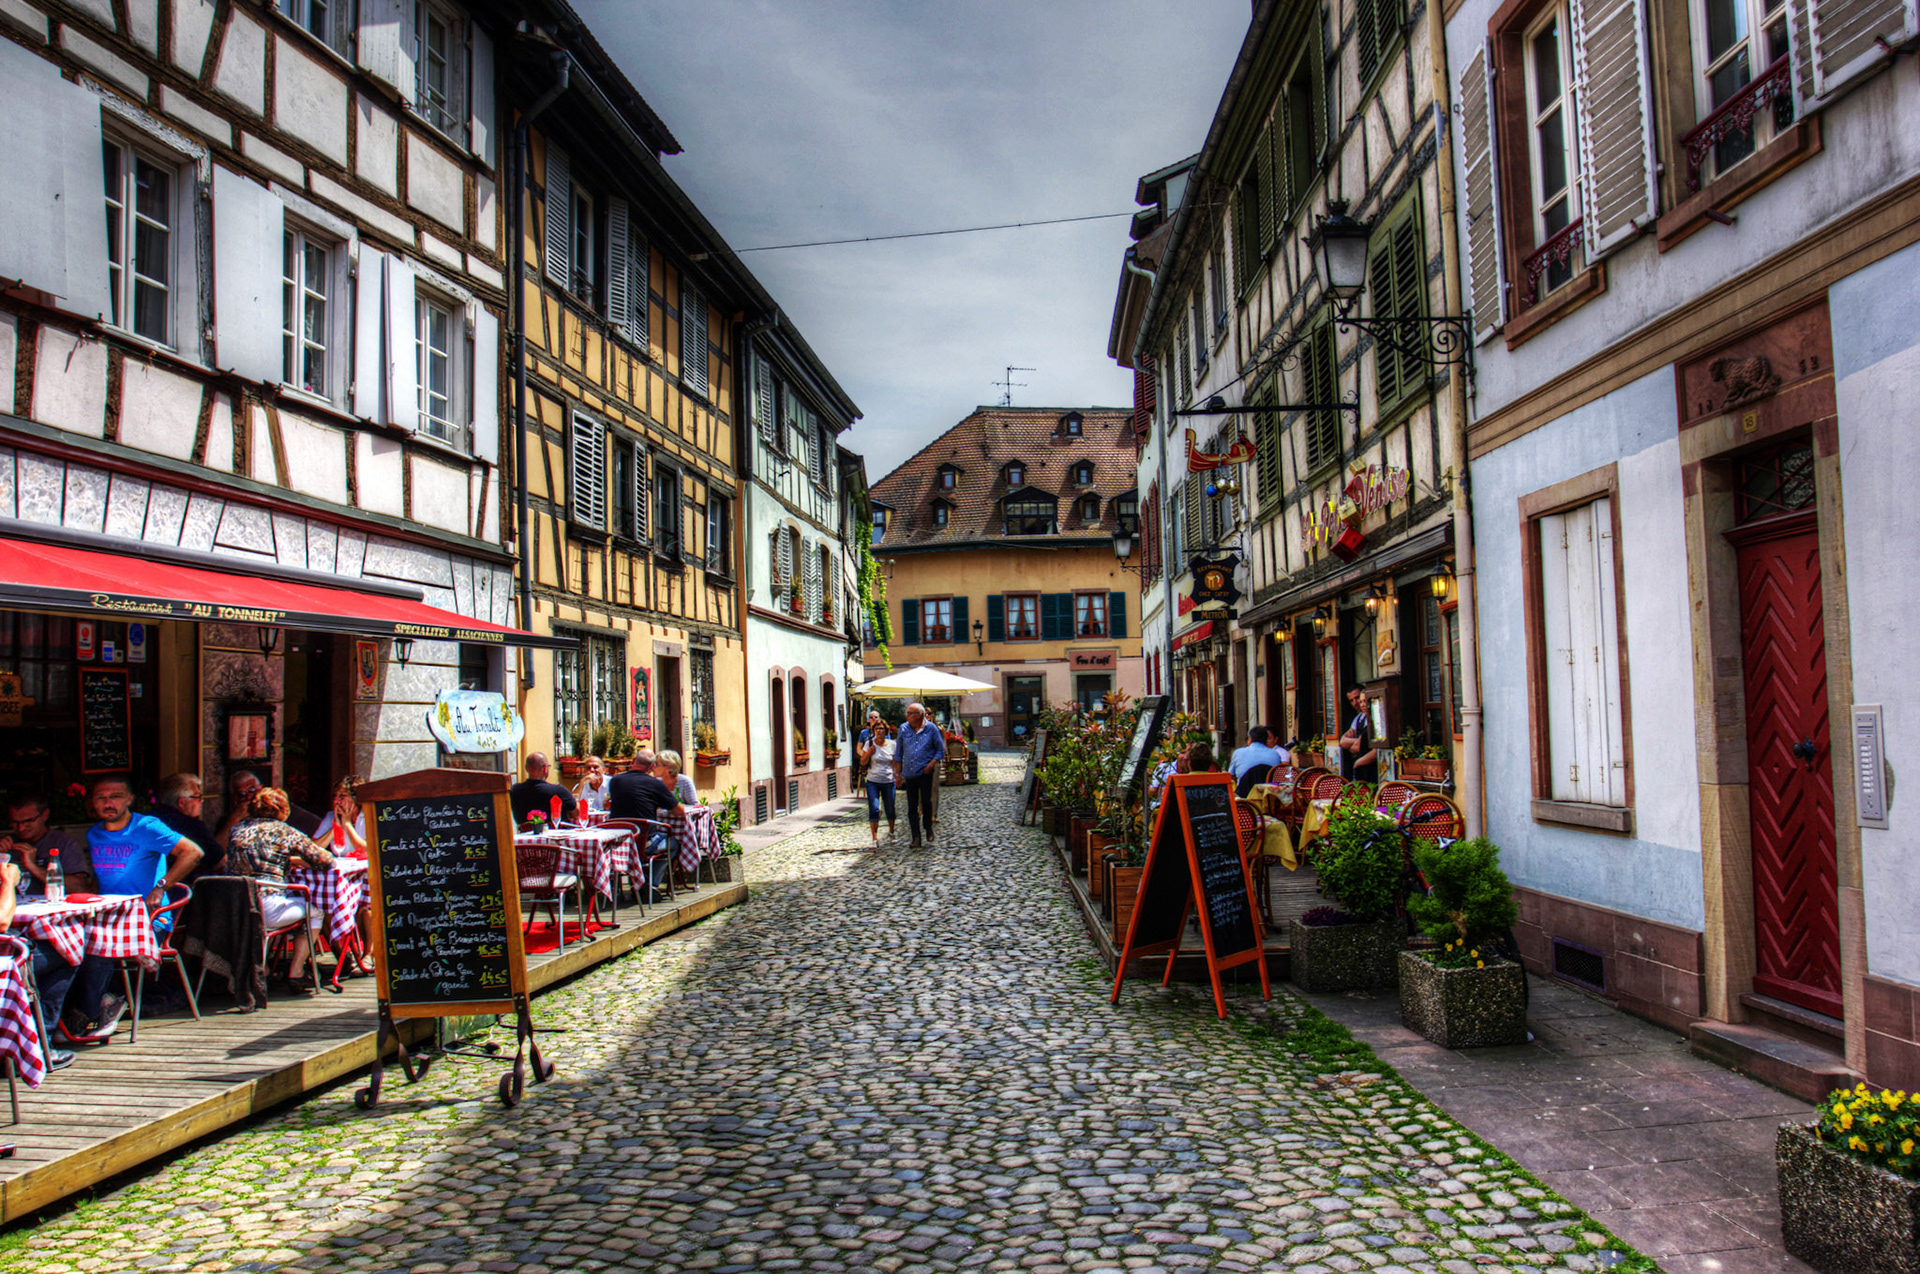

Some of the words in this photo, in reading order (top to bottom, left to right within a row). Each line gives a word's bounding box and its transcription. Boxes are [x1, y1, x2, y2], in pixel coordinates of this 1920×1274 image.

[1353, 463, 1409, 520] Venise
[90, 593, 173, 615] Restaurant
[1201, 609, 1229, 619] METEOR
[394, 623, 450, 638] SPECIALITES
[454, 629, 504, 642] ALSACIENNES
